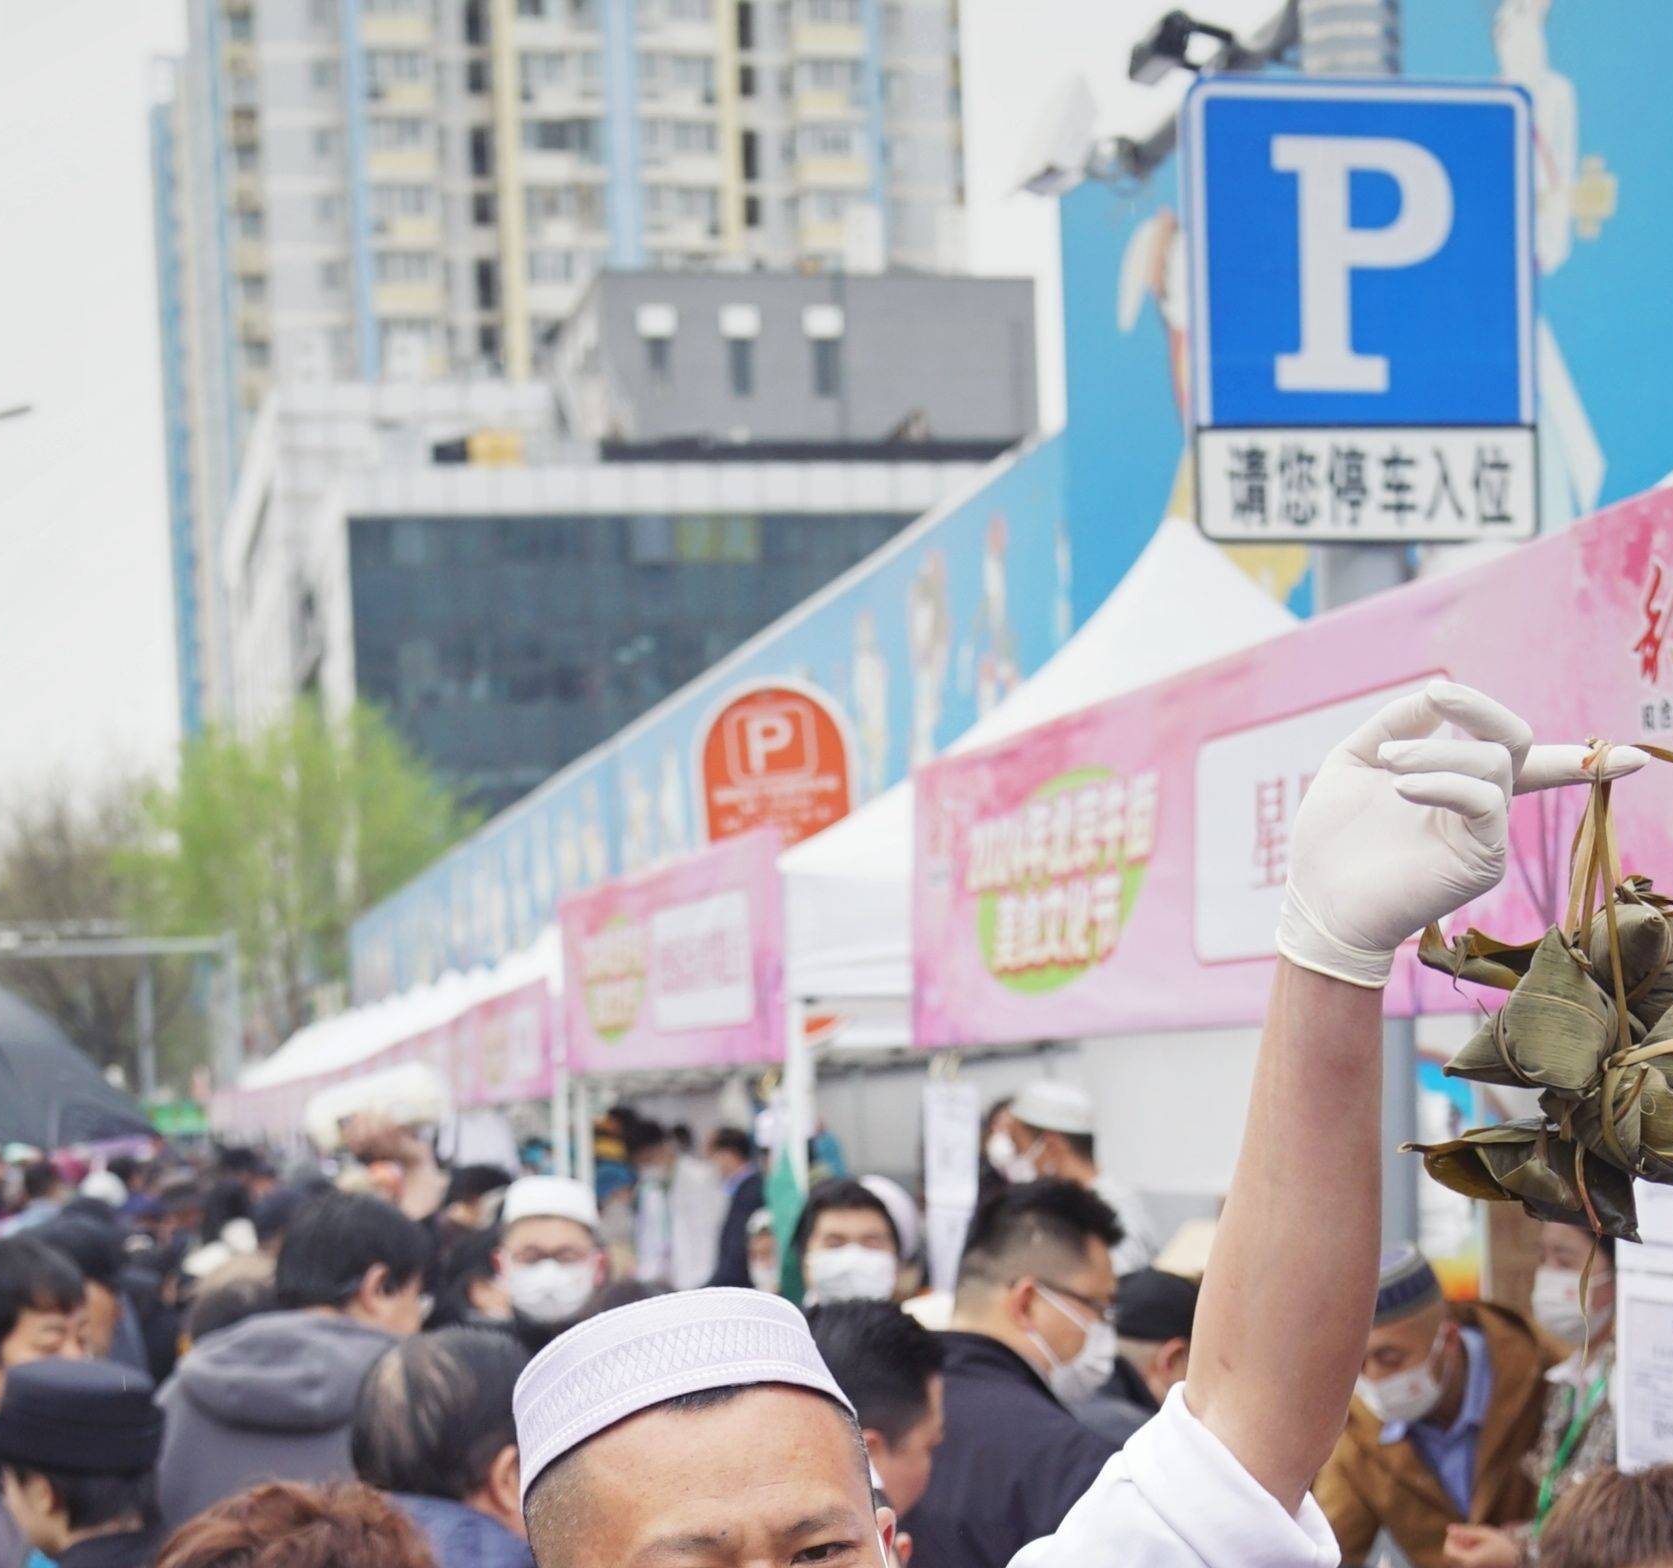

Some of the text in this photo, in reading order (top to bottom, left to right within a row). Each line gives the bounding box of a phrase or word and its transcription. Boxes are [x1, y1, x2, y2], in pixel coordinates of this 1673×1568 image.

[1271, 134, 1455, 393] P
[1227, 445, 1514, 529] 请您停车入位
